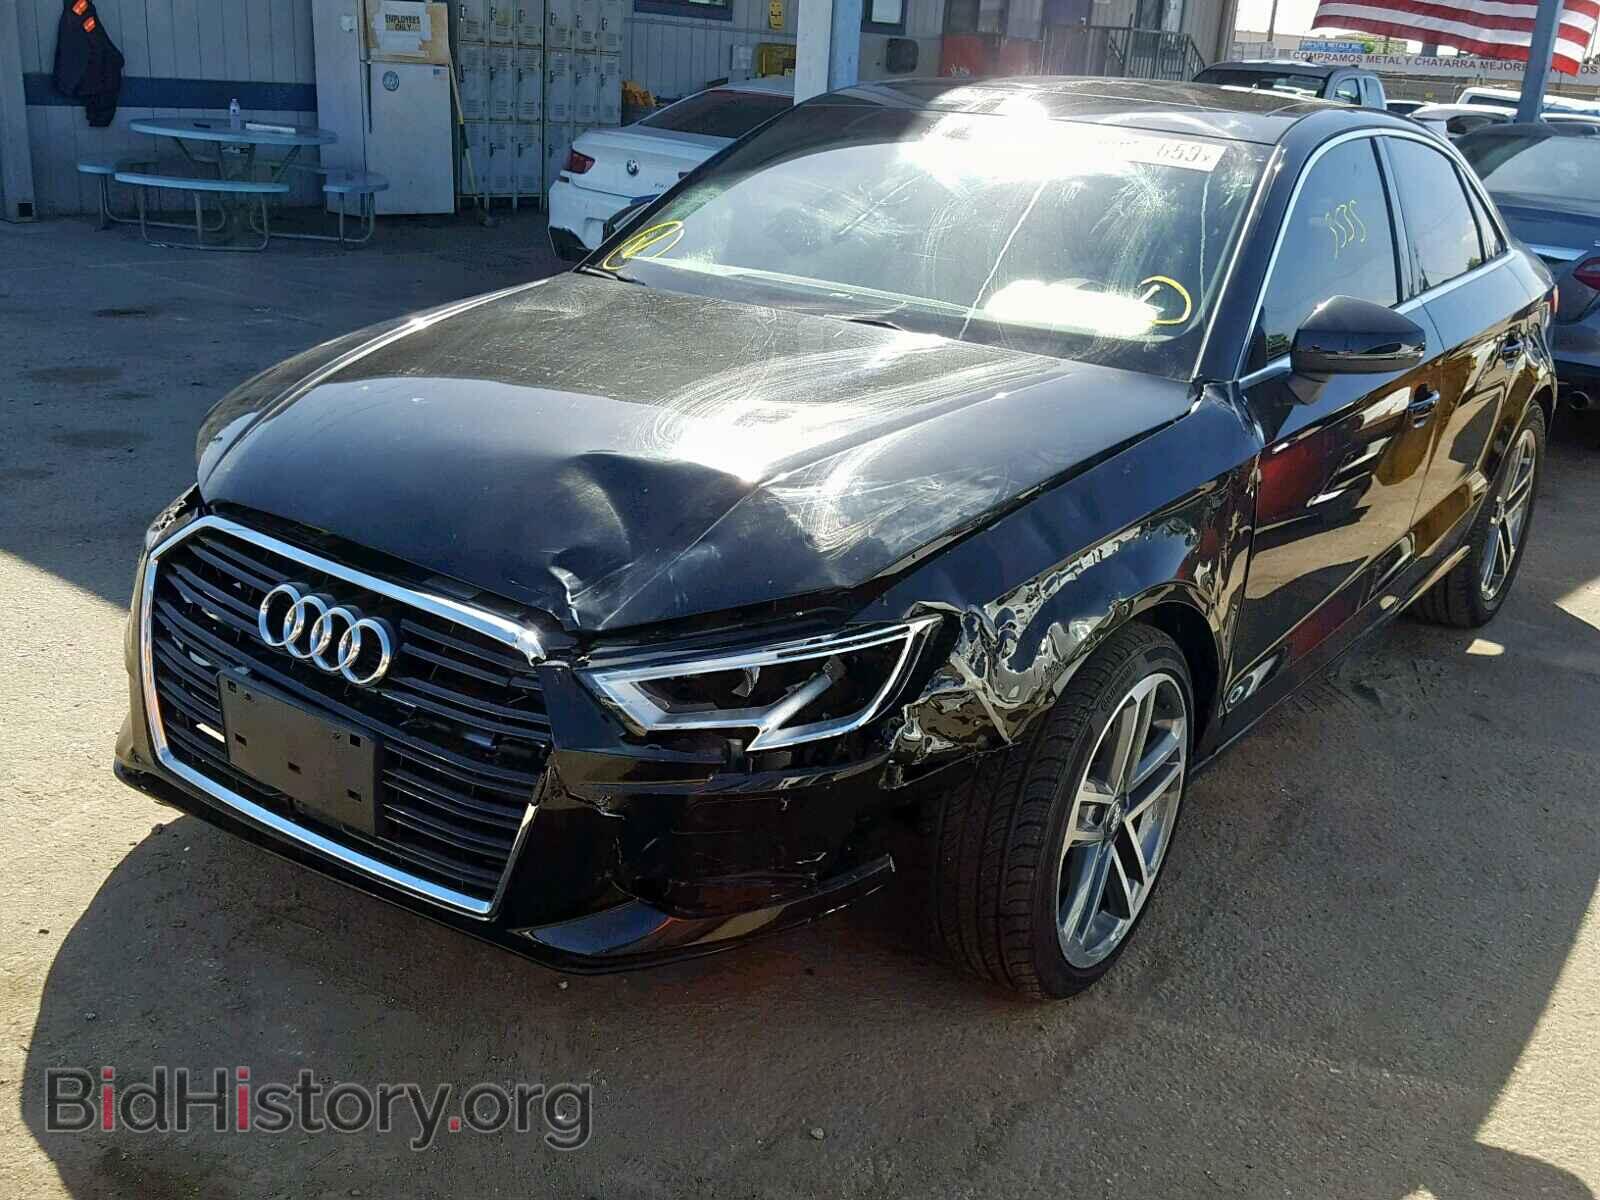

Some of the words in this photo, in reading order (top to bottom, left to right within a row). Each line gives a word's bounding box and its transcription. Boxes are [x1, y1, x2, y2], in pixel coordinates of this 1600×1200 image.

[385, 14, 421, 24] EMPLOYEES
[1293, 51, 1362, 63] COMPRAMOS
[1365, 55, 1402, 65] METAL
[1403, 56, 1412, 65] Y
[1414, 57, 1476, 69] CHATARRA
